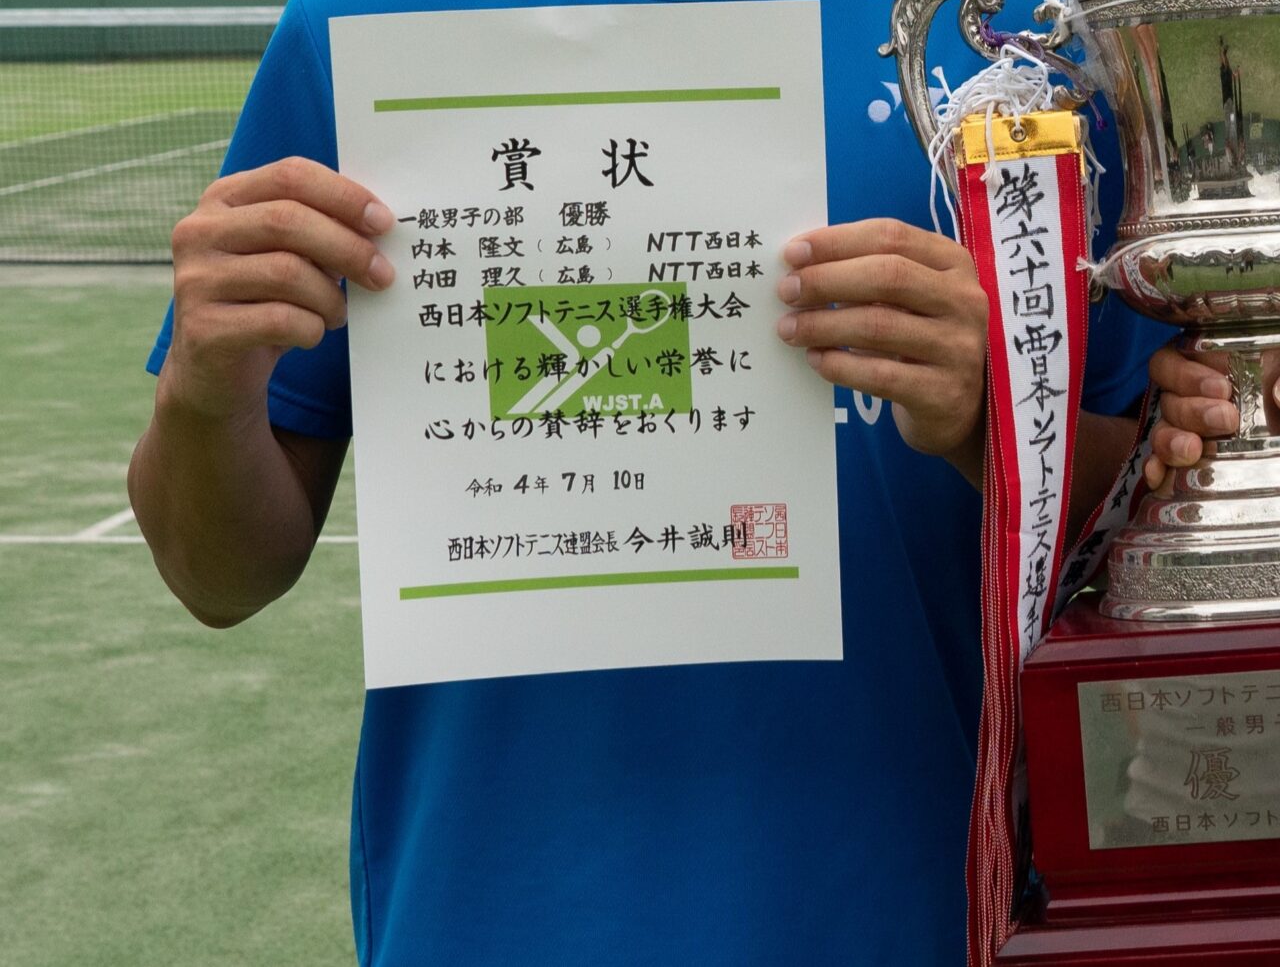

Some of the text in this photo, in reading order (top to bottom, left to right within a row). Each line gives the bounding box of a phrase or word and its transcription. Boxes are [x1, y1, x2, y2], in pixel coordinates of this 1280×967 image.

[491, 137, 654, 191] 賞状
[398, 201, 611, 230] 一般男子の部 優勝
[411, 237, 456, 260] 内本
[478, 236, 525, 258] 隆文
[646, 229, 762, 253] NTT西日本
[413, 268, 457, 290] 内田
[481, 266, 525, 288] 理久
[648, 260, 764, 283] NTT西日本
[418, 291, 751, 328] 西日本ソフトテニス選手権大会
[424, 346, 752, 384] における輝かしい栄誉に
[582, 393, 664, 412] WJST.A
[424, 405, 756, 440] 心からの賛辞をおくります
[448, 521, 748, 562] 西日本ソフトテニス連盟会長 今井誠則
